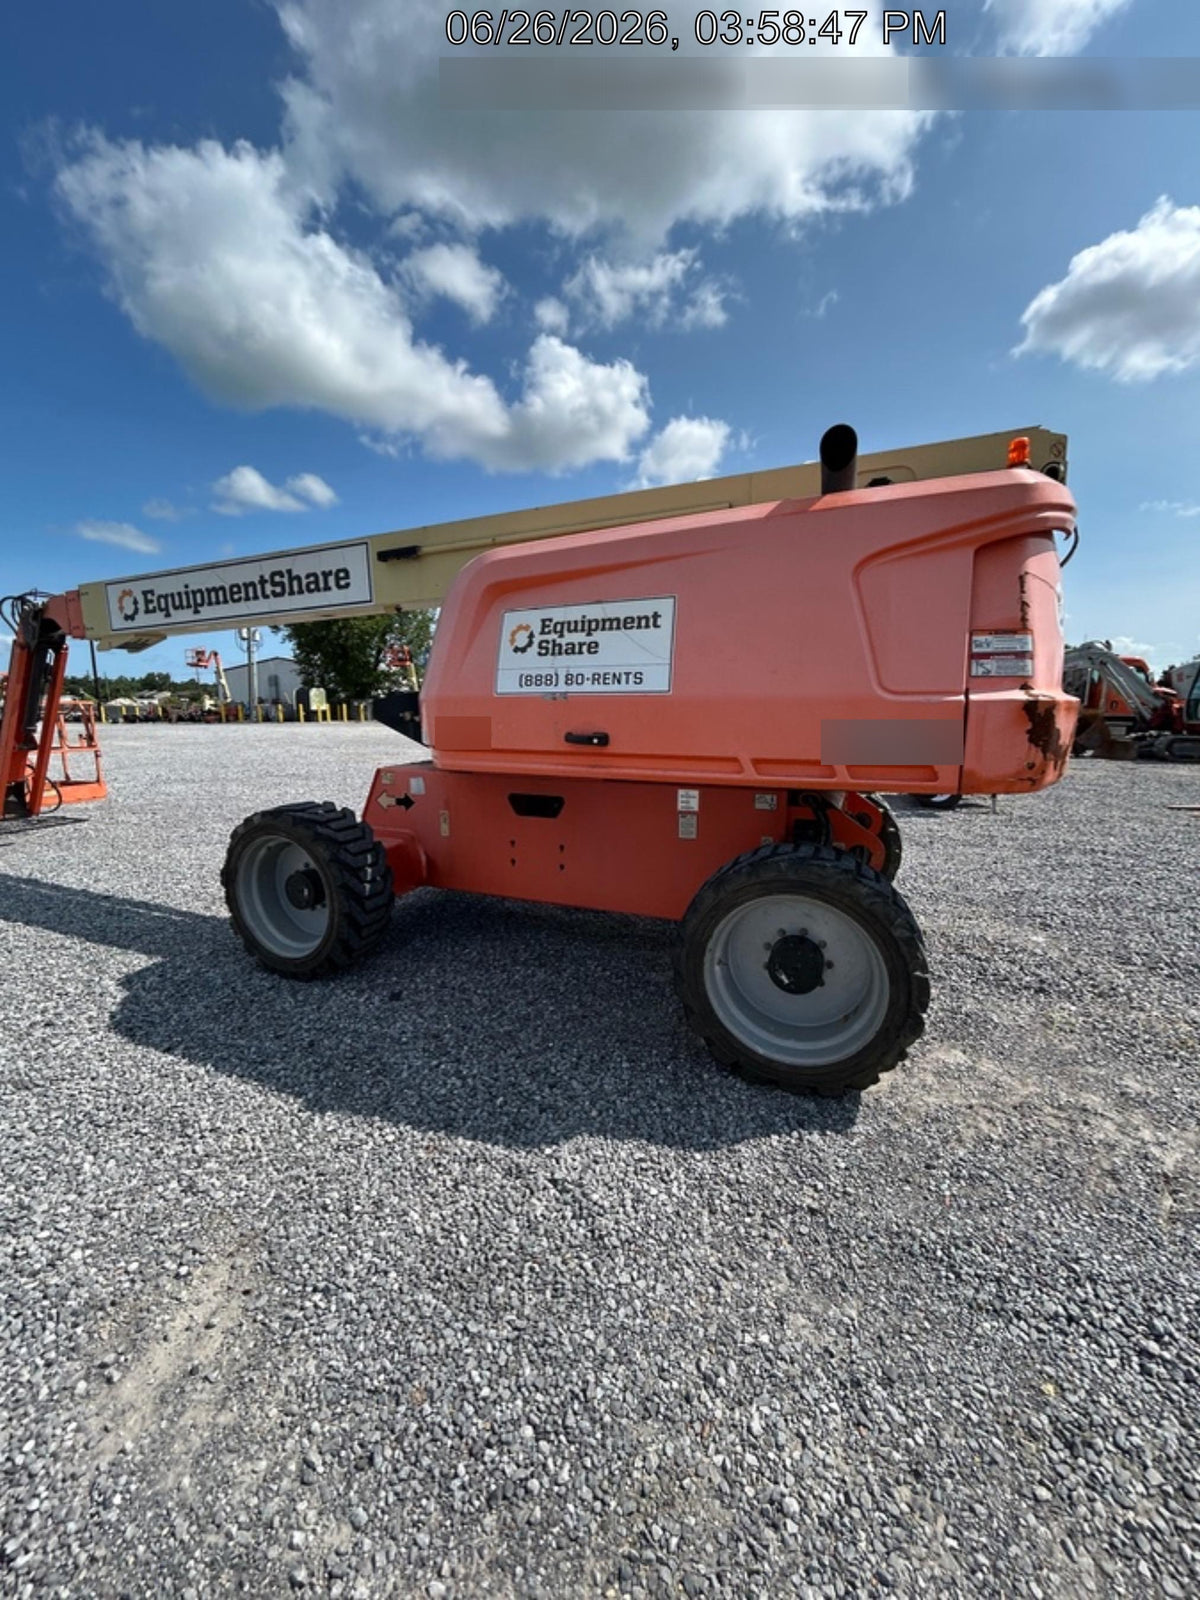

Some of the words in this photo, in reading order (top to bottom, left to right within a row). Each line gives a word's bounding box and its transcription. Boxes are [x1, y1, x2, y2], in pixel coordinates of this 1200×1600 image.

[142, 567, 351, 617] EquipmentShare
[539, 611, 662, 638] Equipment
[537, 639, 600, 657] Share
[518, 673, 559, 688] (888)
